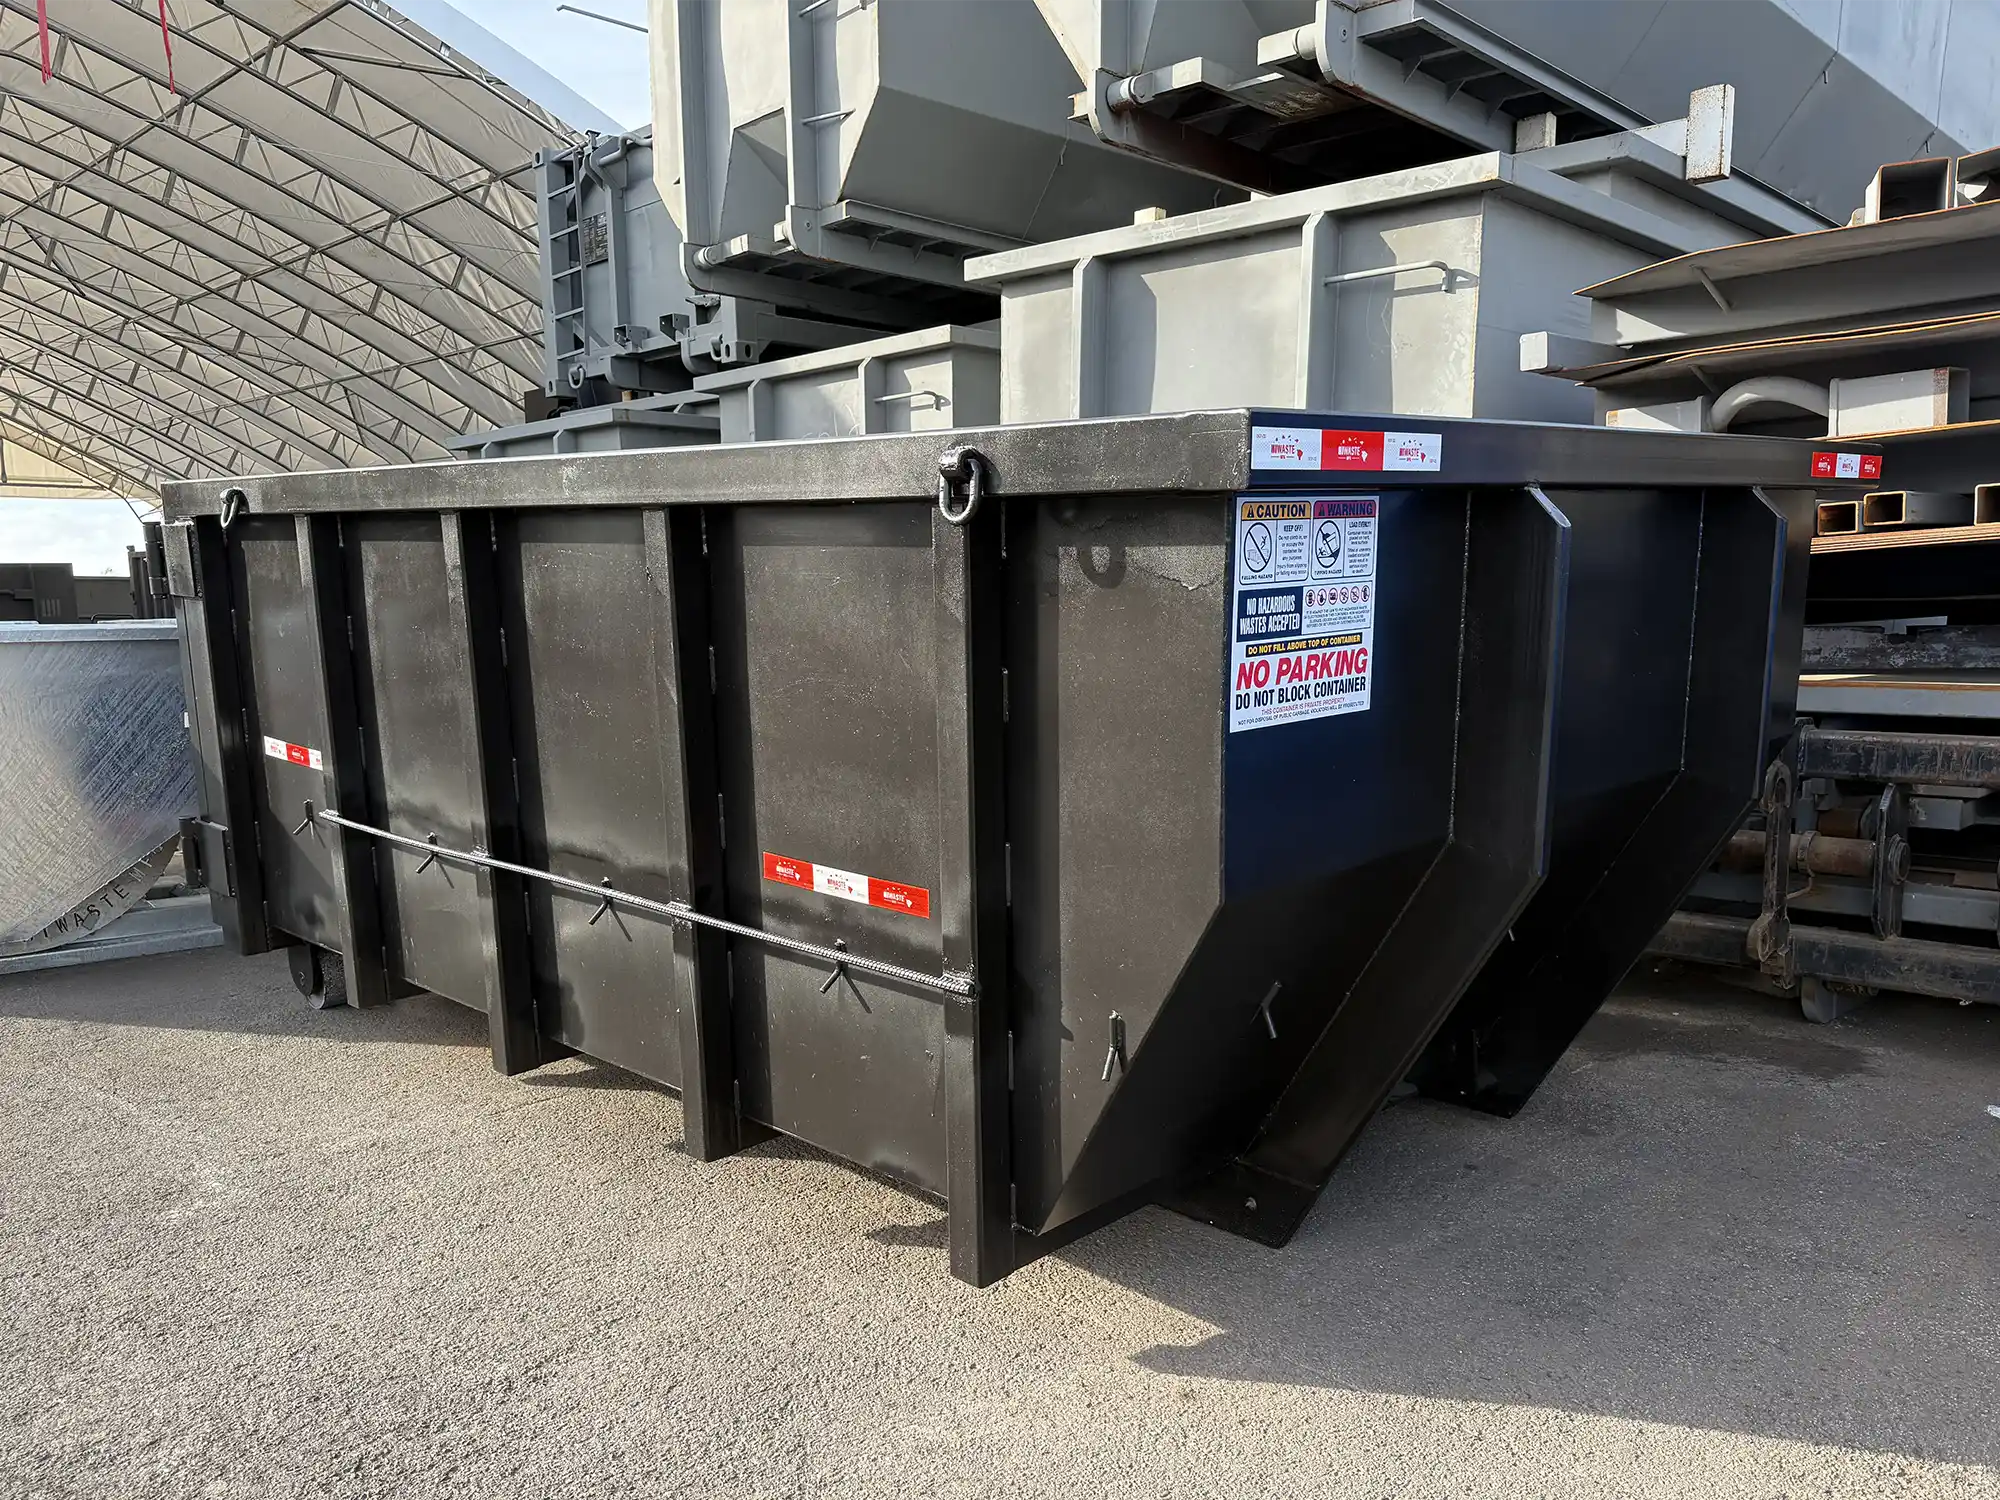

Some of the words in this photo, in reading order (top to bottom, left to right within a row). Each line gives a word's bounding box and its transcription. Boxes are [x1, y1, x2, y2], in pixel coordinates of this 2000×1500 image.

[1256, 504, 1306, 518] CAUTION
[1328, 503, 1372, 516] WARNING
[1247, 598, 1256, 615] NO
[1258, 595, 1295, 614] HAZARDOUS
[1240, 616, 1266, 635] WASTES
[1268, 613, 1300, 632] ACCEPTED
[1248, 646, 1257, 654] DO
[1259, 645, 1272, 653] NOT
[1273, 644, 1286, 652] FILL
[1287, 641, 1306, 650] ABOVE
[1308, 640, 1319, 648] TOP
[1320, 638, 1328, 646] OF
[1330, 635, 1360, 645] CONTAINER
[1236, 660, 1270, 690] NO
[1276, 648, 1368, 685] PARKING
[1236, 692, 1250, 710] DO
[1254, 689, 1275, 708] NOT
[1278, 684, 1311, 704] BLOCK
[1314, 676, 1366, 697] CONTAINER
[1261, 707, 1272, 715] THIS
[1273, 704, 1298, 714] CONTAINER
